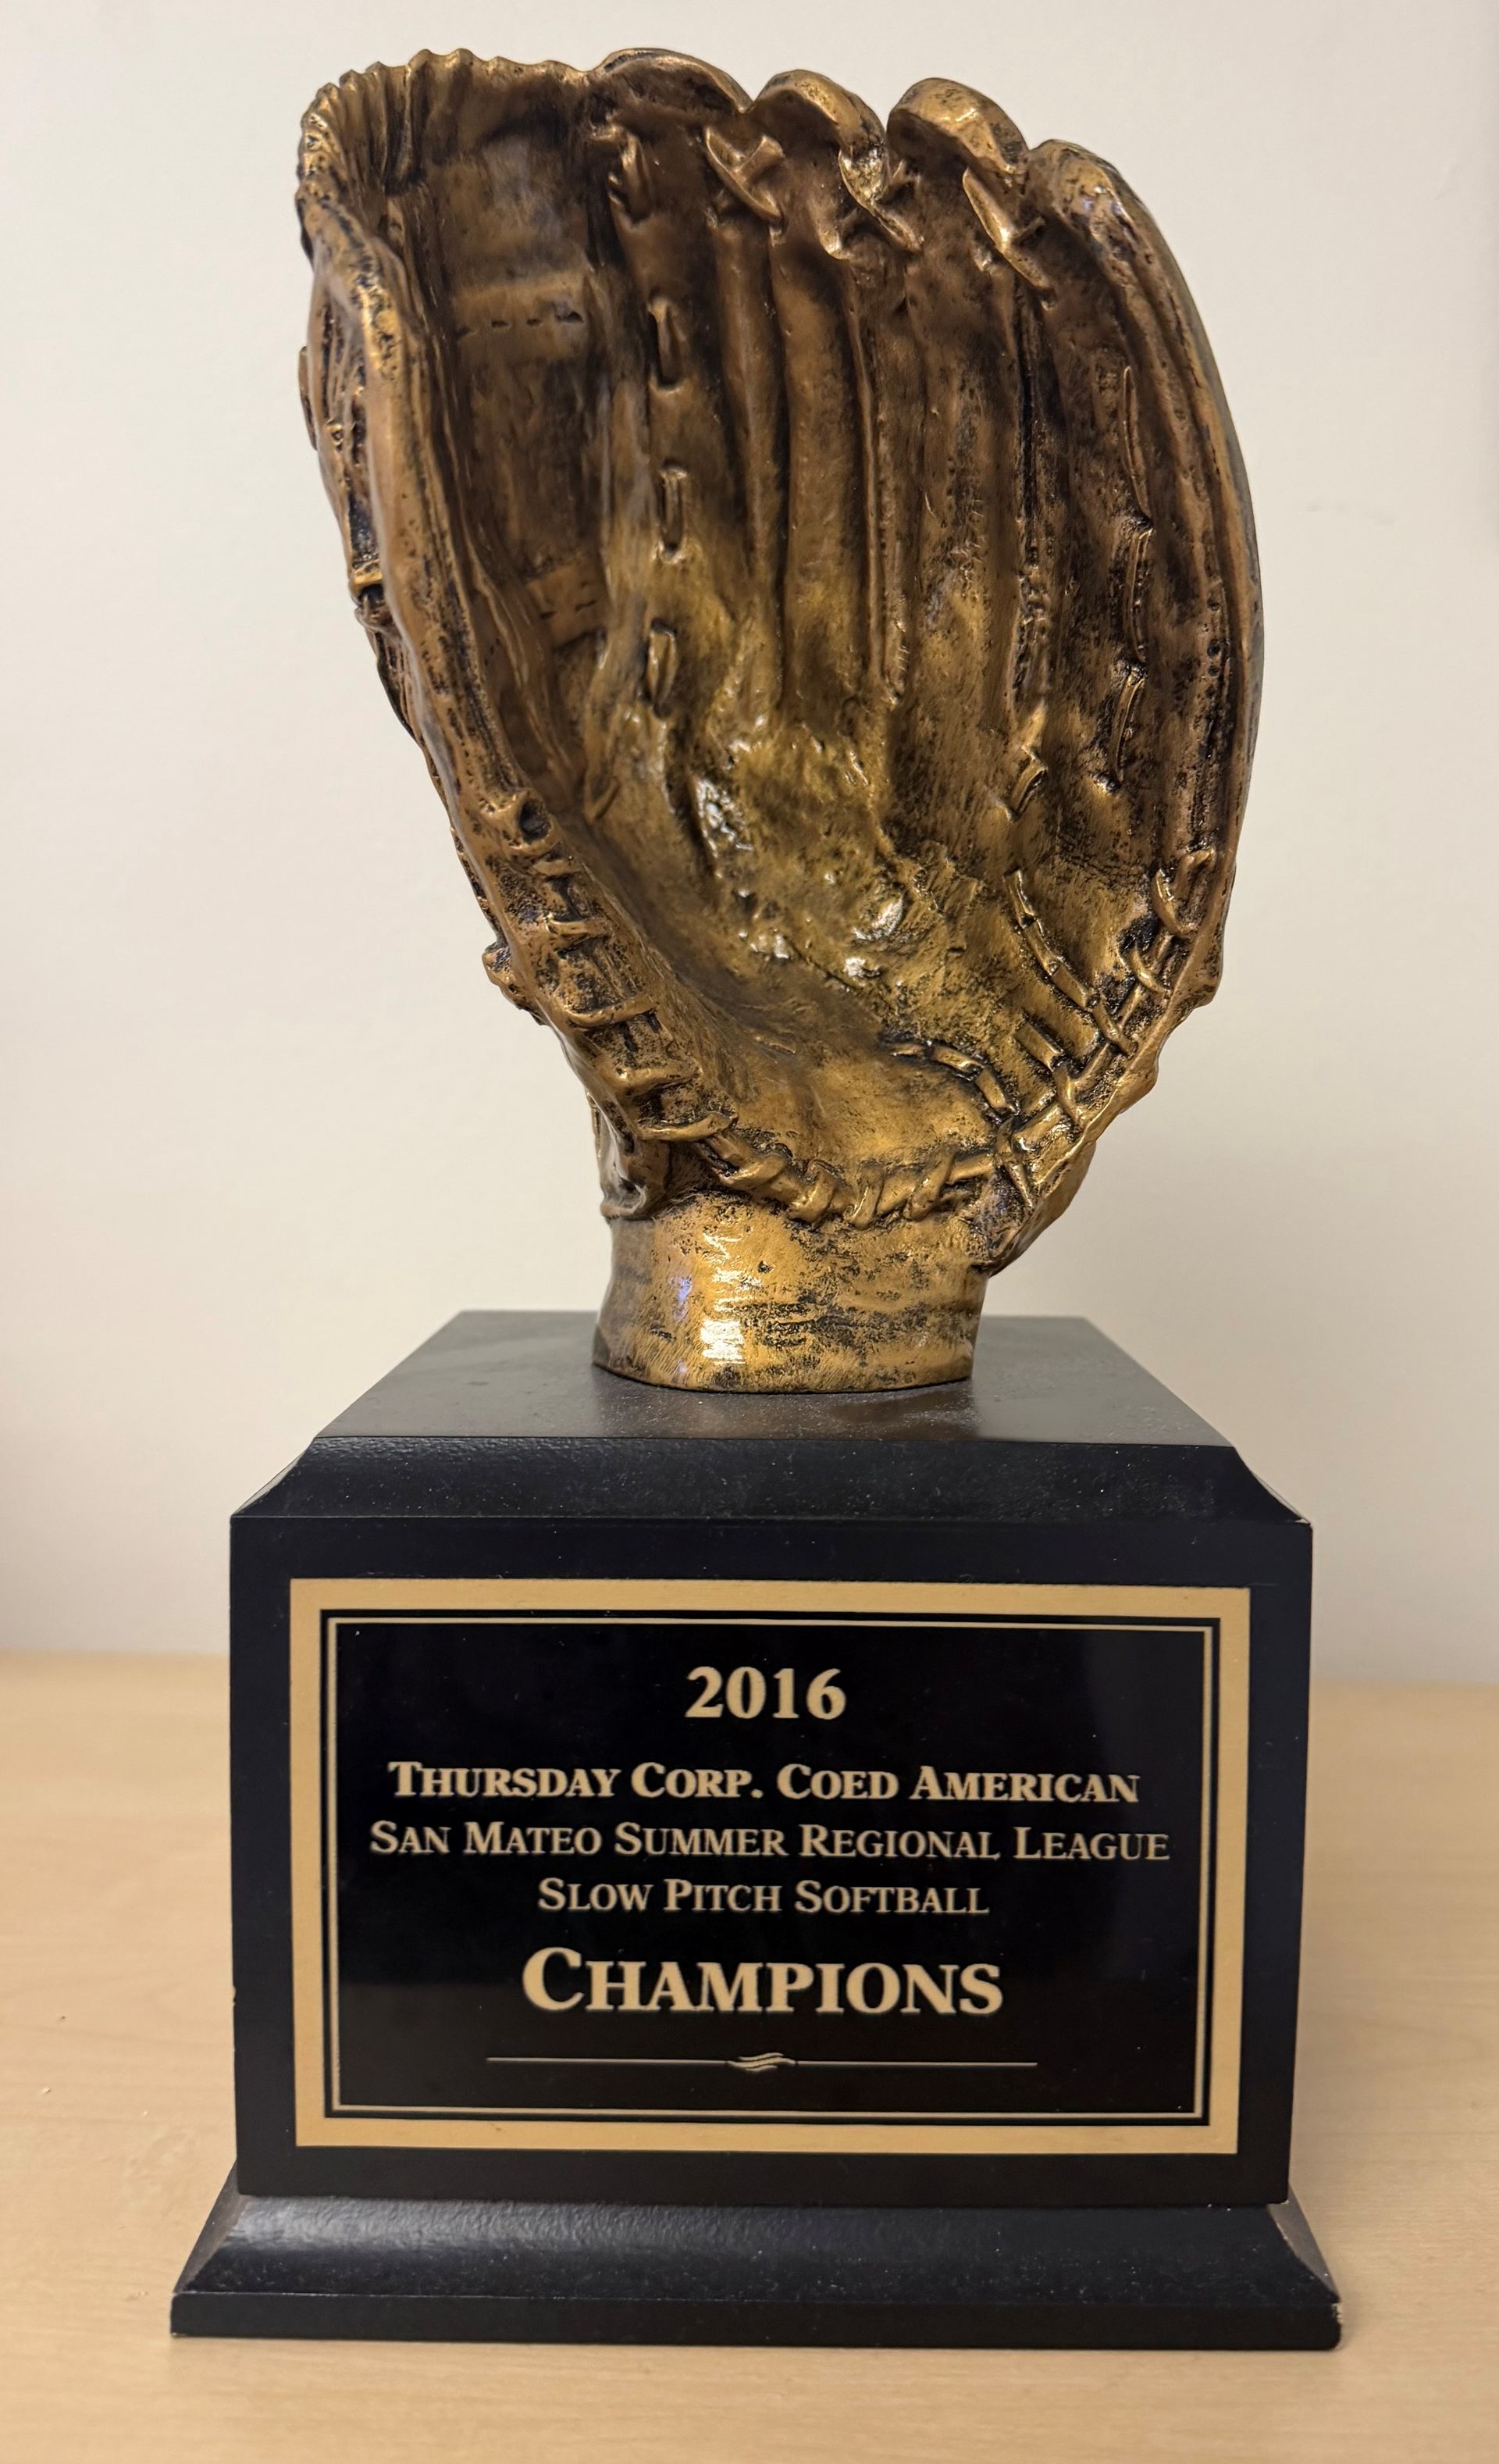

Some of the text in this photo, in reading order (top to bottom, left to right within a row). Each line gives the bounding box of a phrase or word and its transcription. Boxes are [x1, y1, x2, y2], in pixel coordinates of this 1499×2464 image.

[685, 1666, 846, 1720] 2016
[388, 1761, 1140, 1803] THURSDAY CORP. COED AMERICAN
[370, 1820, 1170, 1861] SAN MATEO SUMMER REGIONAL LEAGUE
[538, 1877, 990, 1914] SLOW PITCH SOFTBALL
[522, 1947, 1003, 2014] CHAMPIONS
